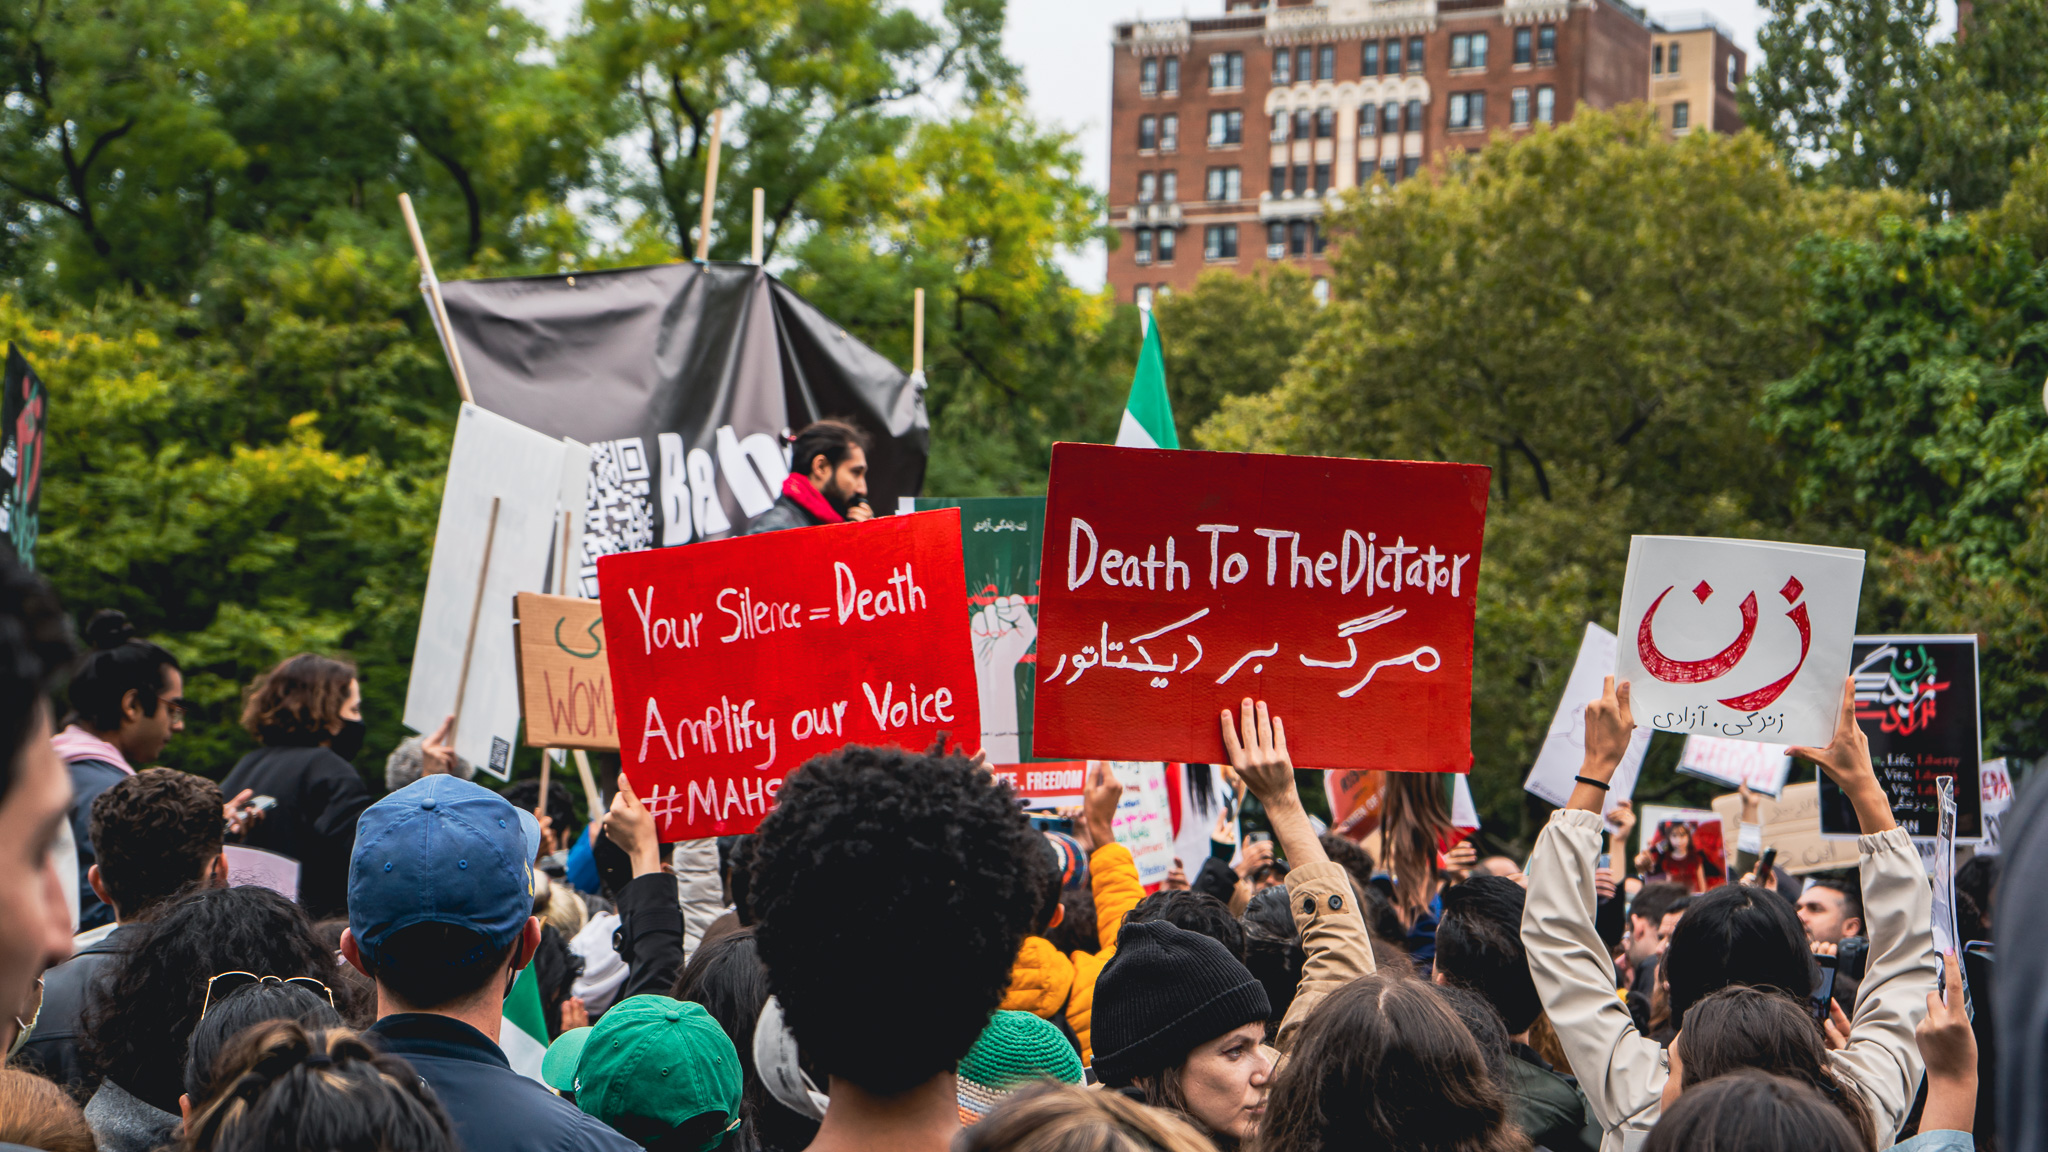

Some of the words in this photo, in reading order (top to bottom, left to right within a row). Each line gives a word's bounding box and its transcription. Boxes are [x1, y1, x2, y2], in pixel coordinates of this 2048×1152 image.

[1068, 516, 1190, 591] Death
[1196, 523, 1249, 589] To
[628, 585, 702, 655] Your
[716, 586, 801, 643] Silence
[833, 561, 926, 625] Death
[1043, 607, 1211, 689] دیکتاتور
[1636, 575, 1812, 712] زن
[1214, 641, 1279, 685] بر
[1300, 604, 1441, 699] مرگ
[638, 695, 777, 771] Amplify
[790, 700, 848, 737] our
[862, 681, 955, 731] Voice
[1652, 705, 1709, 729] آزادی
[1026, 769, 1084, 791] FREEDOM
